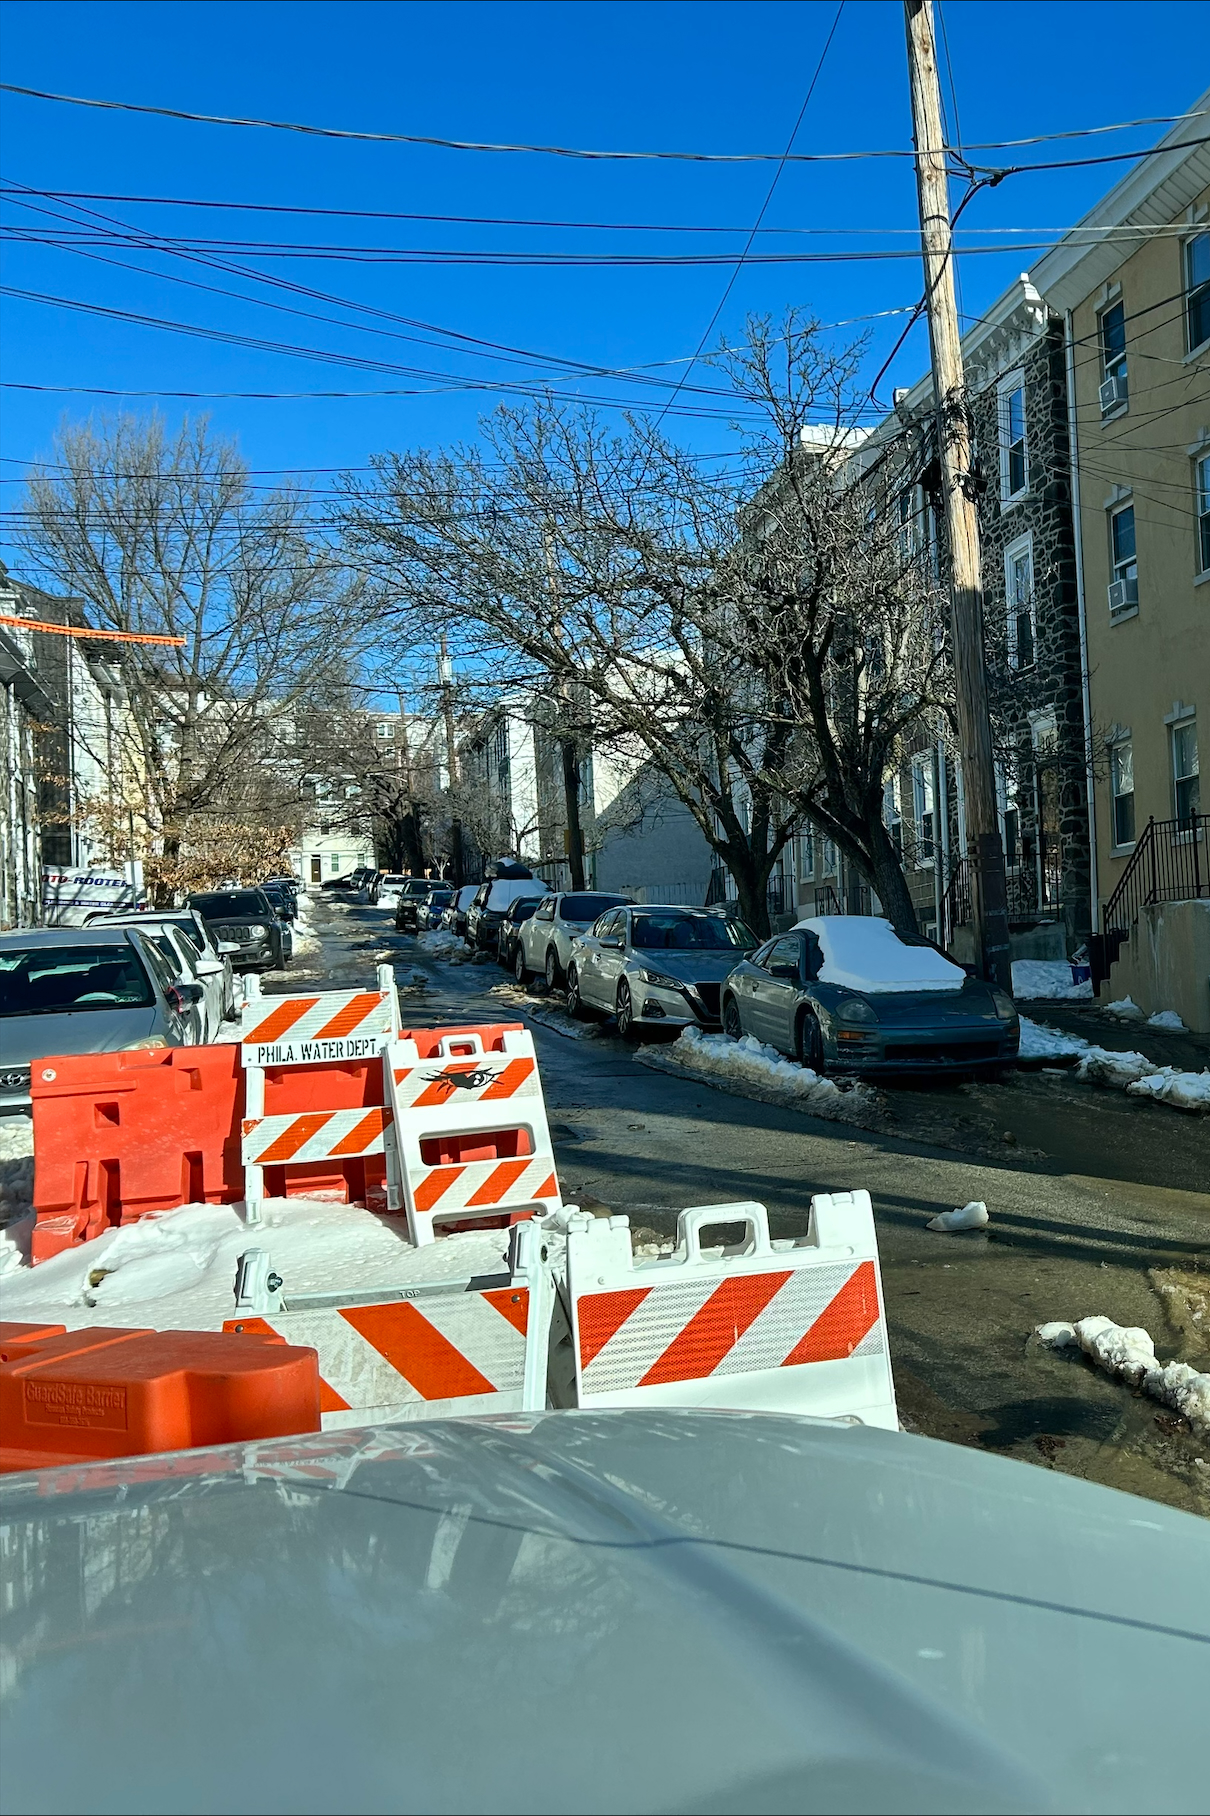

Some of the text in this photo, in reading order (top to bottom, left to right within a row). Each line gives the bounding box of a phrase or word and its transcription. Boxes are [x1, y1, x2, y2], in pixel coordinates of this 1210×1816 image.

[258, 1038, 380, 1063] PHILA. WATER DEPT.
[399, 1289, 421, 1298] TOP
[26, 1381, 83, 1404] GuardSafe
[86, 1385, 126, 1409] Barrier
